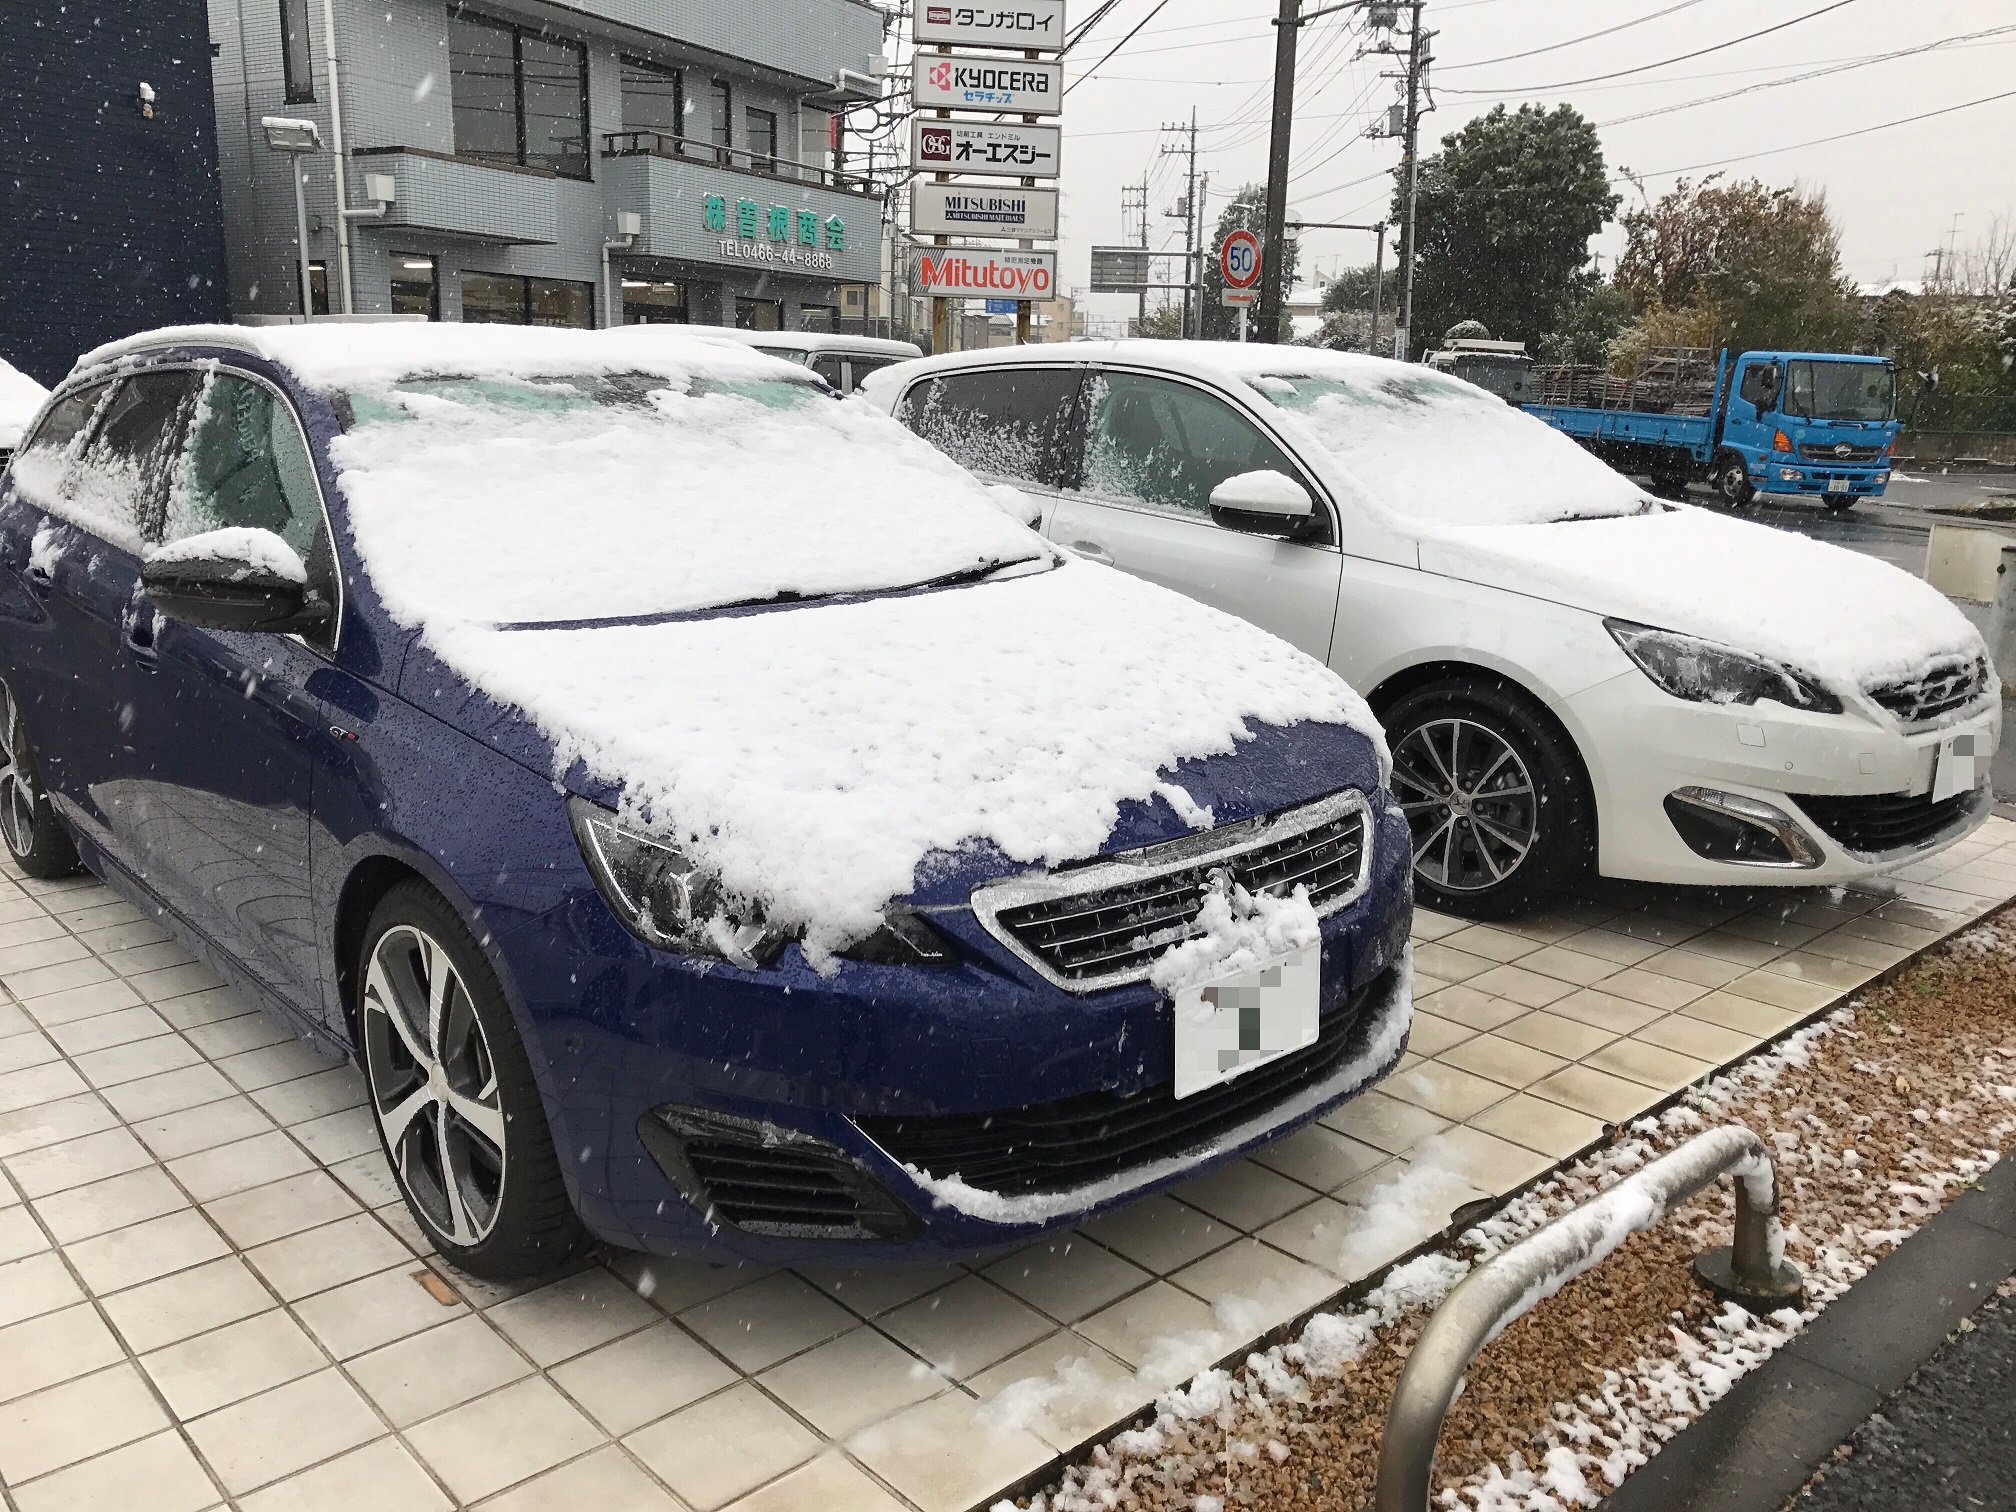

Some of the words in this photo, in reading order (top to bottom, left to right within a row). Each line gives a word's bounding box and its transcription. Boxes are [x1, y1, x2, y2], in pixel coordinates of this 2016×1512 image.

[955, 8, 1054, 32] タンガロイ
[954, 67, 1049, 93] KYOCERA
[963, 90, 1013, 104] セラチップ
[987, 132, 1021, 142] エンドミル
[955, 140, 1052, 165] オーエスジー
[945, 196, 1025, 213] MITSUBISHI
[952, 212, 989, 221] MITSUBISHI
[1230, 247, 1252, 272] 50
[921, 257, 1049, 294] Mitutoyo
